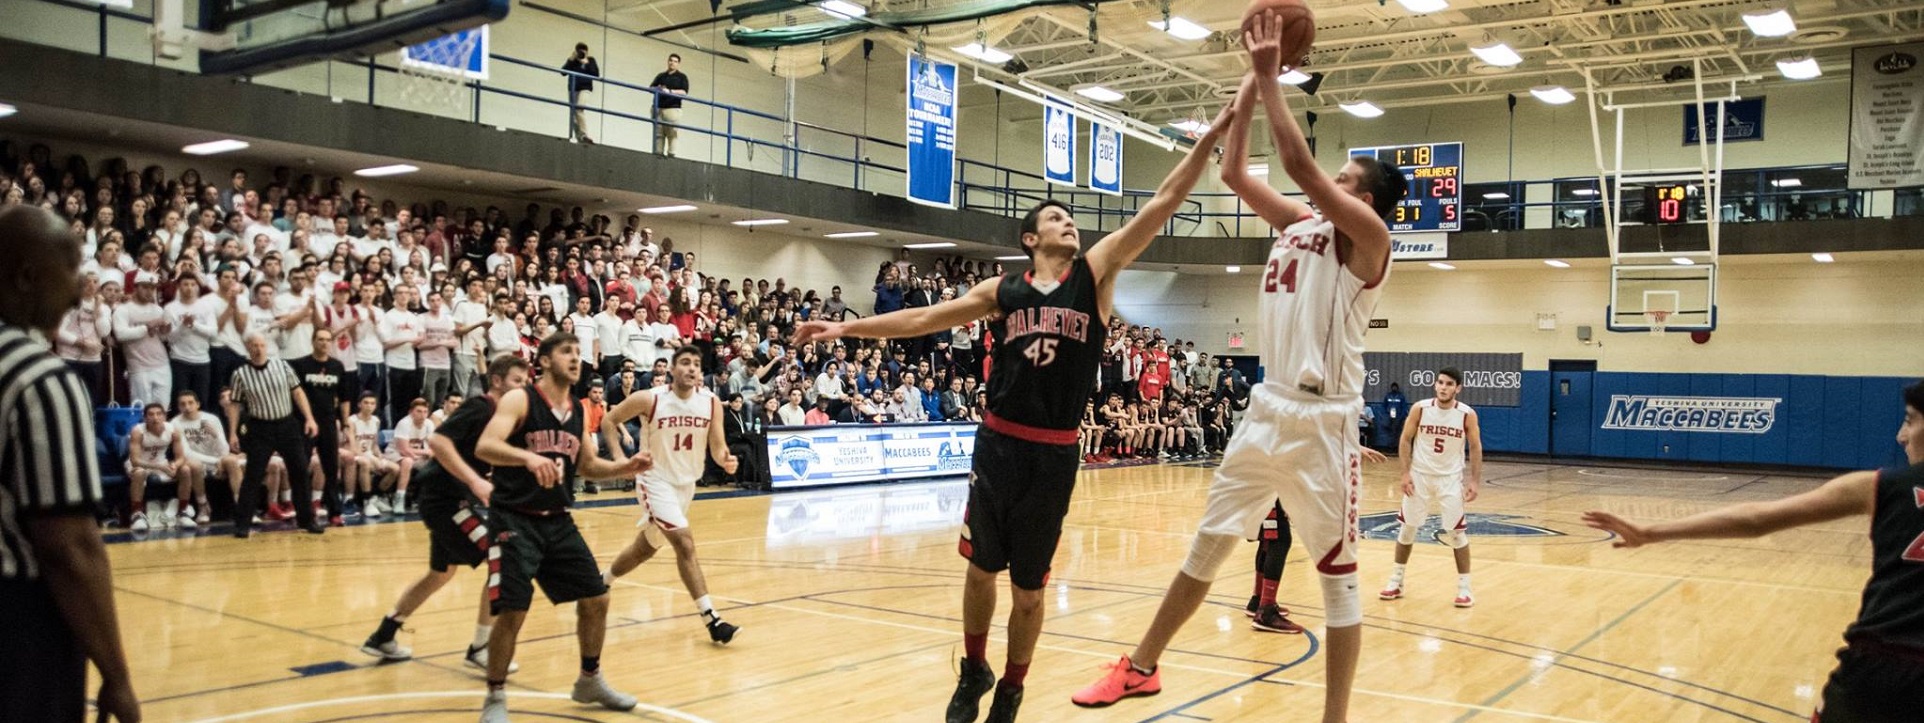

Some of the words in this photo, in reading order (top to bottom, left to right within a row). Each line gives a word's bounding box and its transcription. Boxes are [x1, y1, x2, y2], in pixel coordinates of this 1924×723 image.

[1052, 132, 1067, 150] 416
[1099, 143, 1114, 161] 202
[1396, 147, 1430, 166] 1:18
[1414, 166, 1458, 178] SHALHEVET
[1432, 178, 1456, 197] 29
[1438, 197, 1458, 205] FOULS
[1660, 199, 1679, 220] 10
[1445, 205, 1456, 220] 5
[1265, 258, 1298, 293] 24
[1023, 337, 1060, 367] 45
[1409, 370, 1435, 386] GO
[1463, 371, 1522, 388] MACS!
[657, 416, 710, 429] FRISCH
[1604, 396, 1774, 432] MACCABEES
[1419, 425, 1463, 438] FRISCH
[673, 433, 694, 451] 14
[839, 446, 868, 456] YESHIVA
[1434, 438, 1445, 453] 5
[833, 456, 874, 466] UNIVERSITY
[884, 446, 932, 459] MACCABEES
